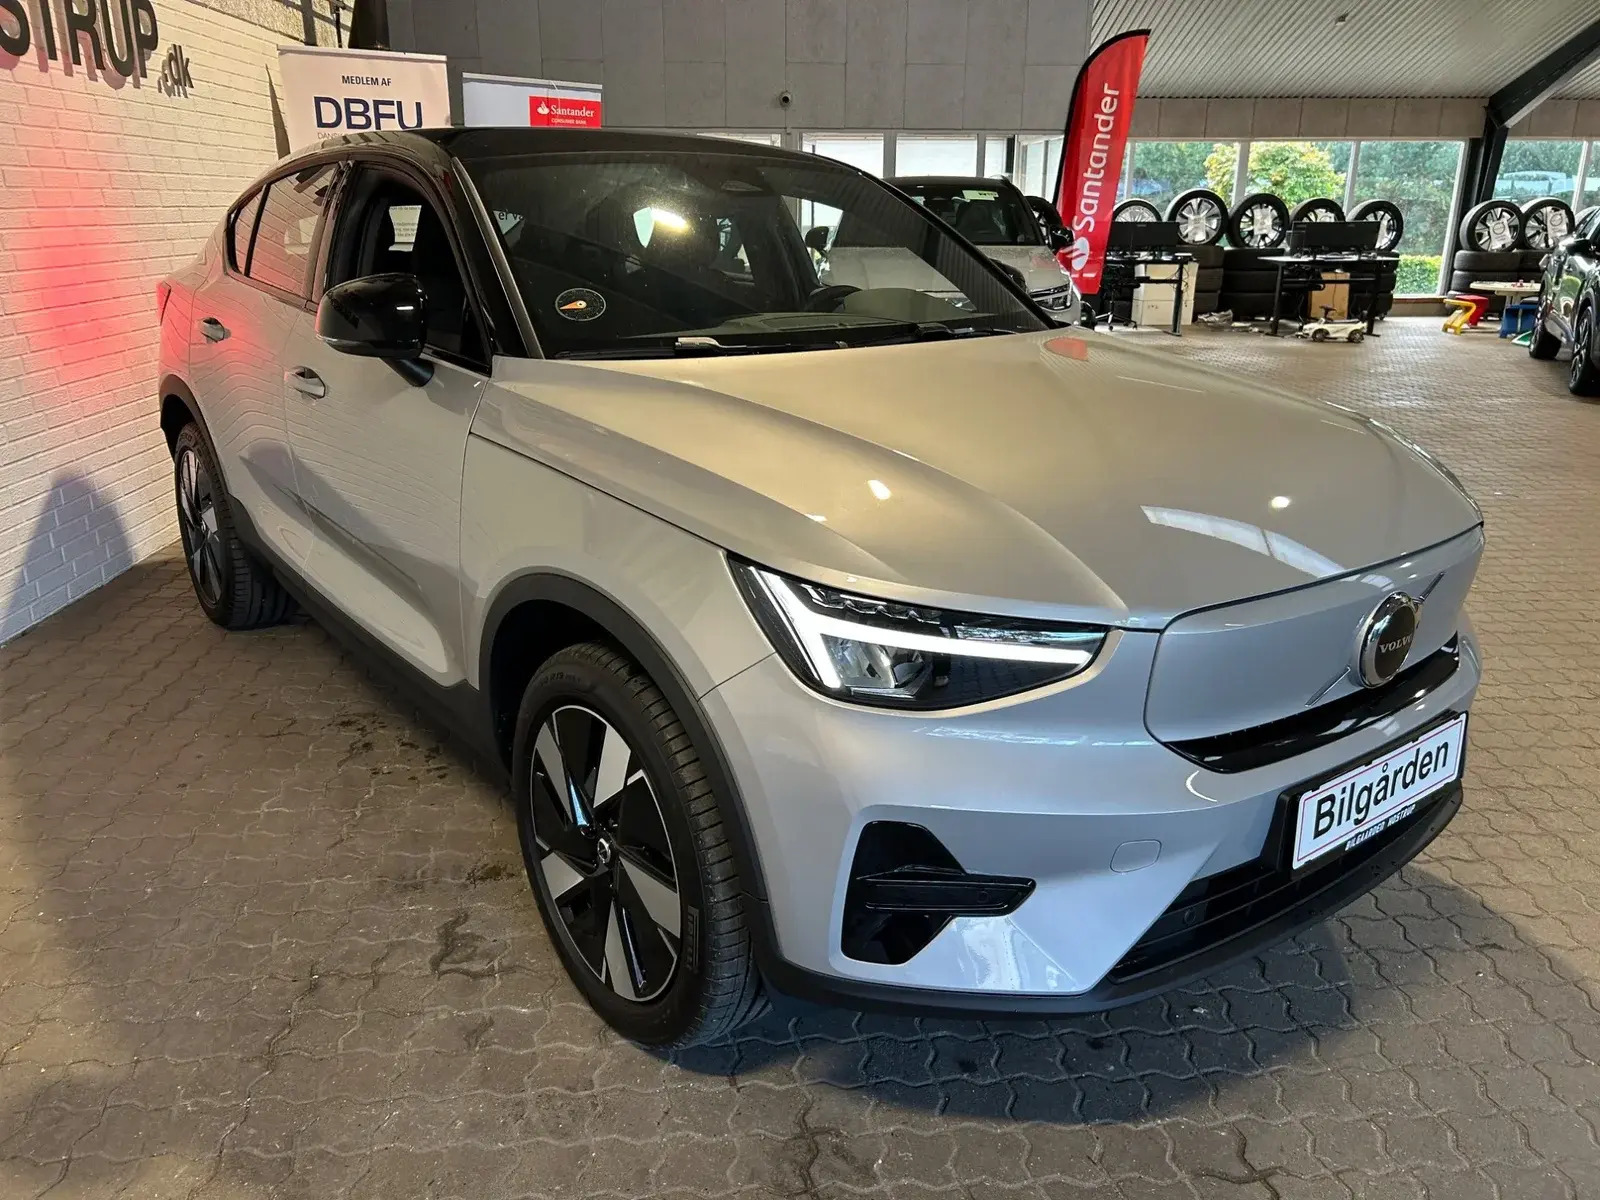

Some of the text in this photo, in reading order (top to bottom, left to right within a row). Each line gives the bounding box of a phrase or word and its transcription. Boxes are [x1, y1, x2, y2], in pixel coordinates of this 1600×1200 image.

[341, 75, 392, 87] MEDLEM AF
[313, 96, 423, 130] DBFU
[550, 104, 594, 117] Santander
[1072, 82, 1120, 233] Santander
[1313, 741, 1449, 840] Bilgården
